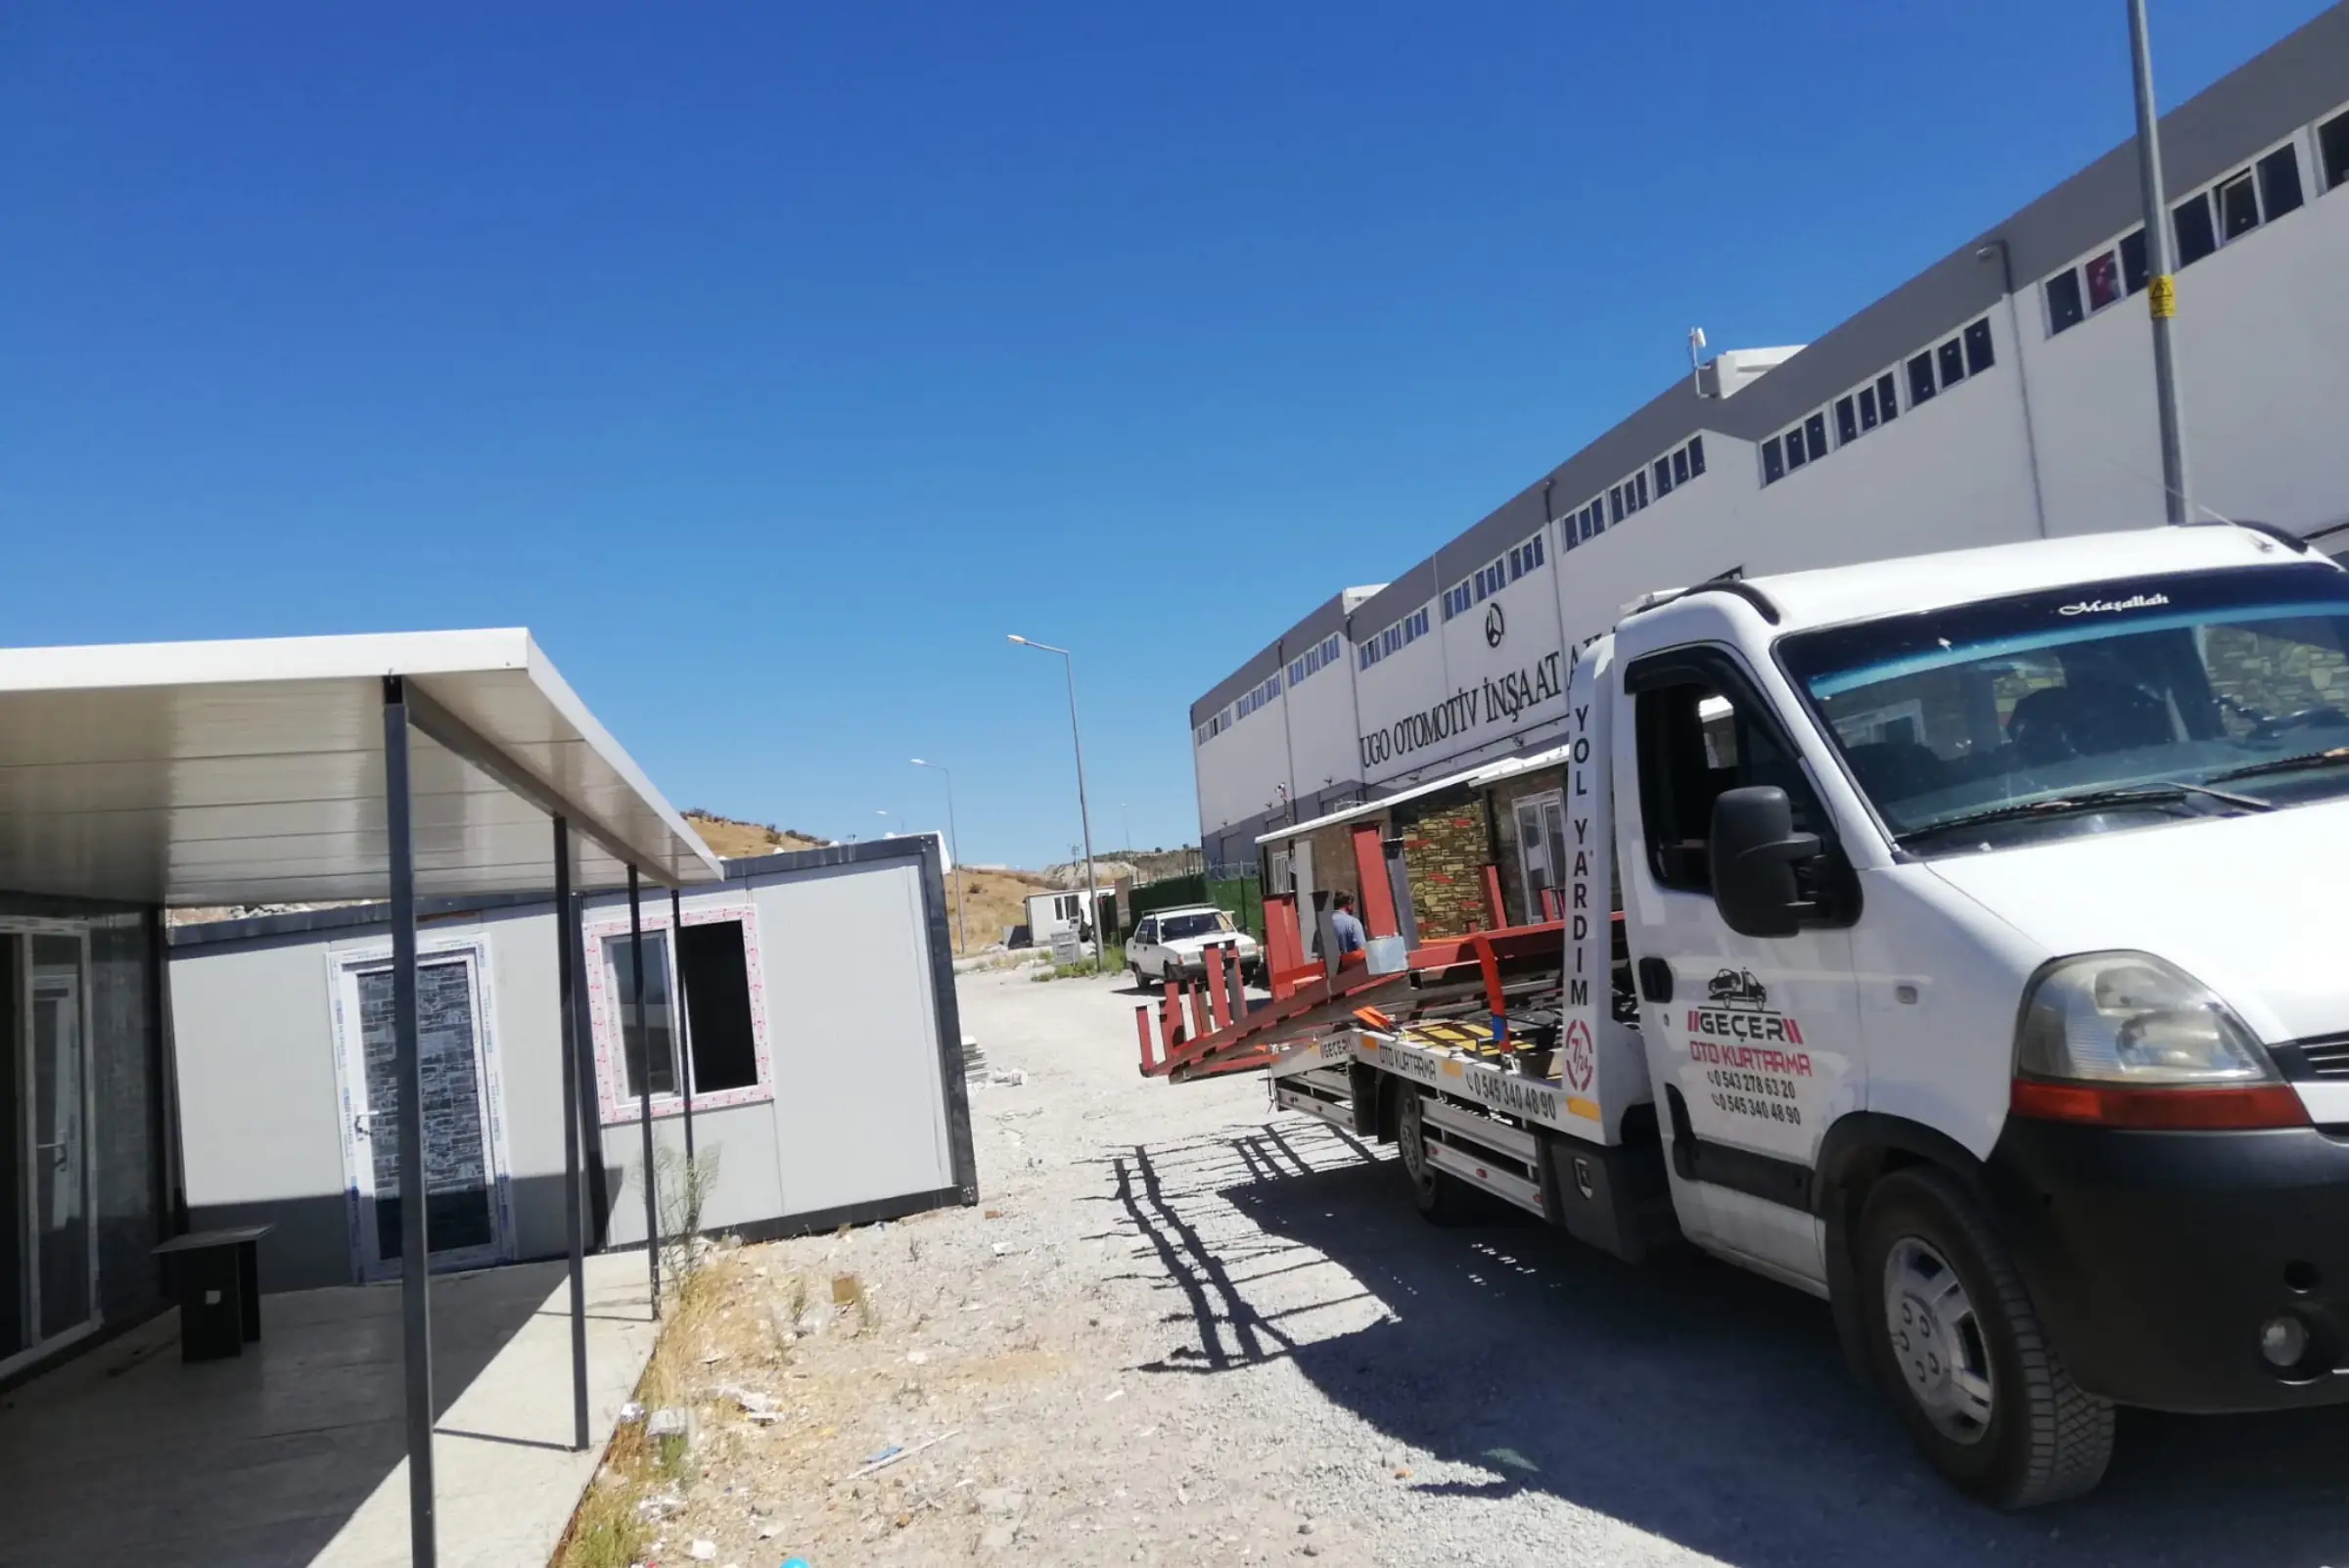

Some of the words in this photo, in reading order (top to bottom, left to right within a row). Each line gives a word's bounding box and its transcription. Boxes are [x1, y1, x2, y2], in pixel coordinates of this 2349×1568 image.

[1359, 728, 1390, 768] UGO
[1394, 688, 1478, 756] OTOMOTİV
[1483, 650, 1562, 722] İNŞAAT
[1574, 704, 1590, 797] YOL
[1570, 817, 1589, 1007] YARDIM
[1699, 1012, 1785, 1043] GEÇER
[1689, 1040, 1721, 1064] OTO
[1722, 1045, 1813, 1077] KURTARMA
[1474, 1072, 1482, 1096] 0
[1482, 1075, 1500, 1103] 545
[1502, 1080, 1523, 1110] 340
[1526, 1087, 1540, 1115] 48
[1540, 1091, 1556, 1121] 90
[1714, 1069, 1722, 1087] 0
[1722, 1071, 1742, 1090] 543
[1765, 1077, 1779, 1097] 63
[1780, 1080, 1796, 1099] 20
[1719, 1092, 1727, 1111] 0
[1727, 1094, 1748, 1115] 545
[1748, 1098, 1769, 1119] 340
[1771, 1102, 1785, 1123] 48
[1785, 1105, 1801, 1127] 90
